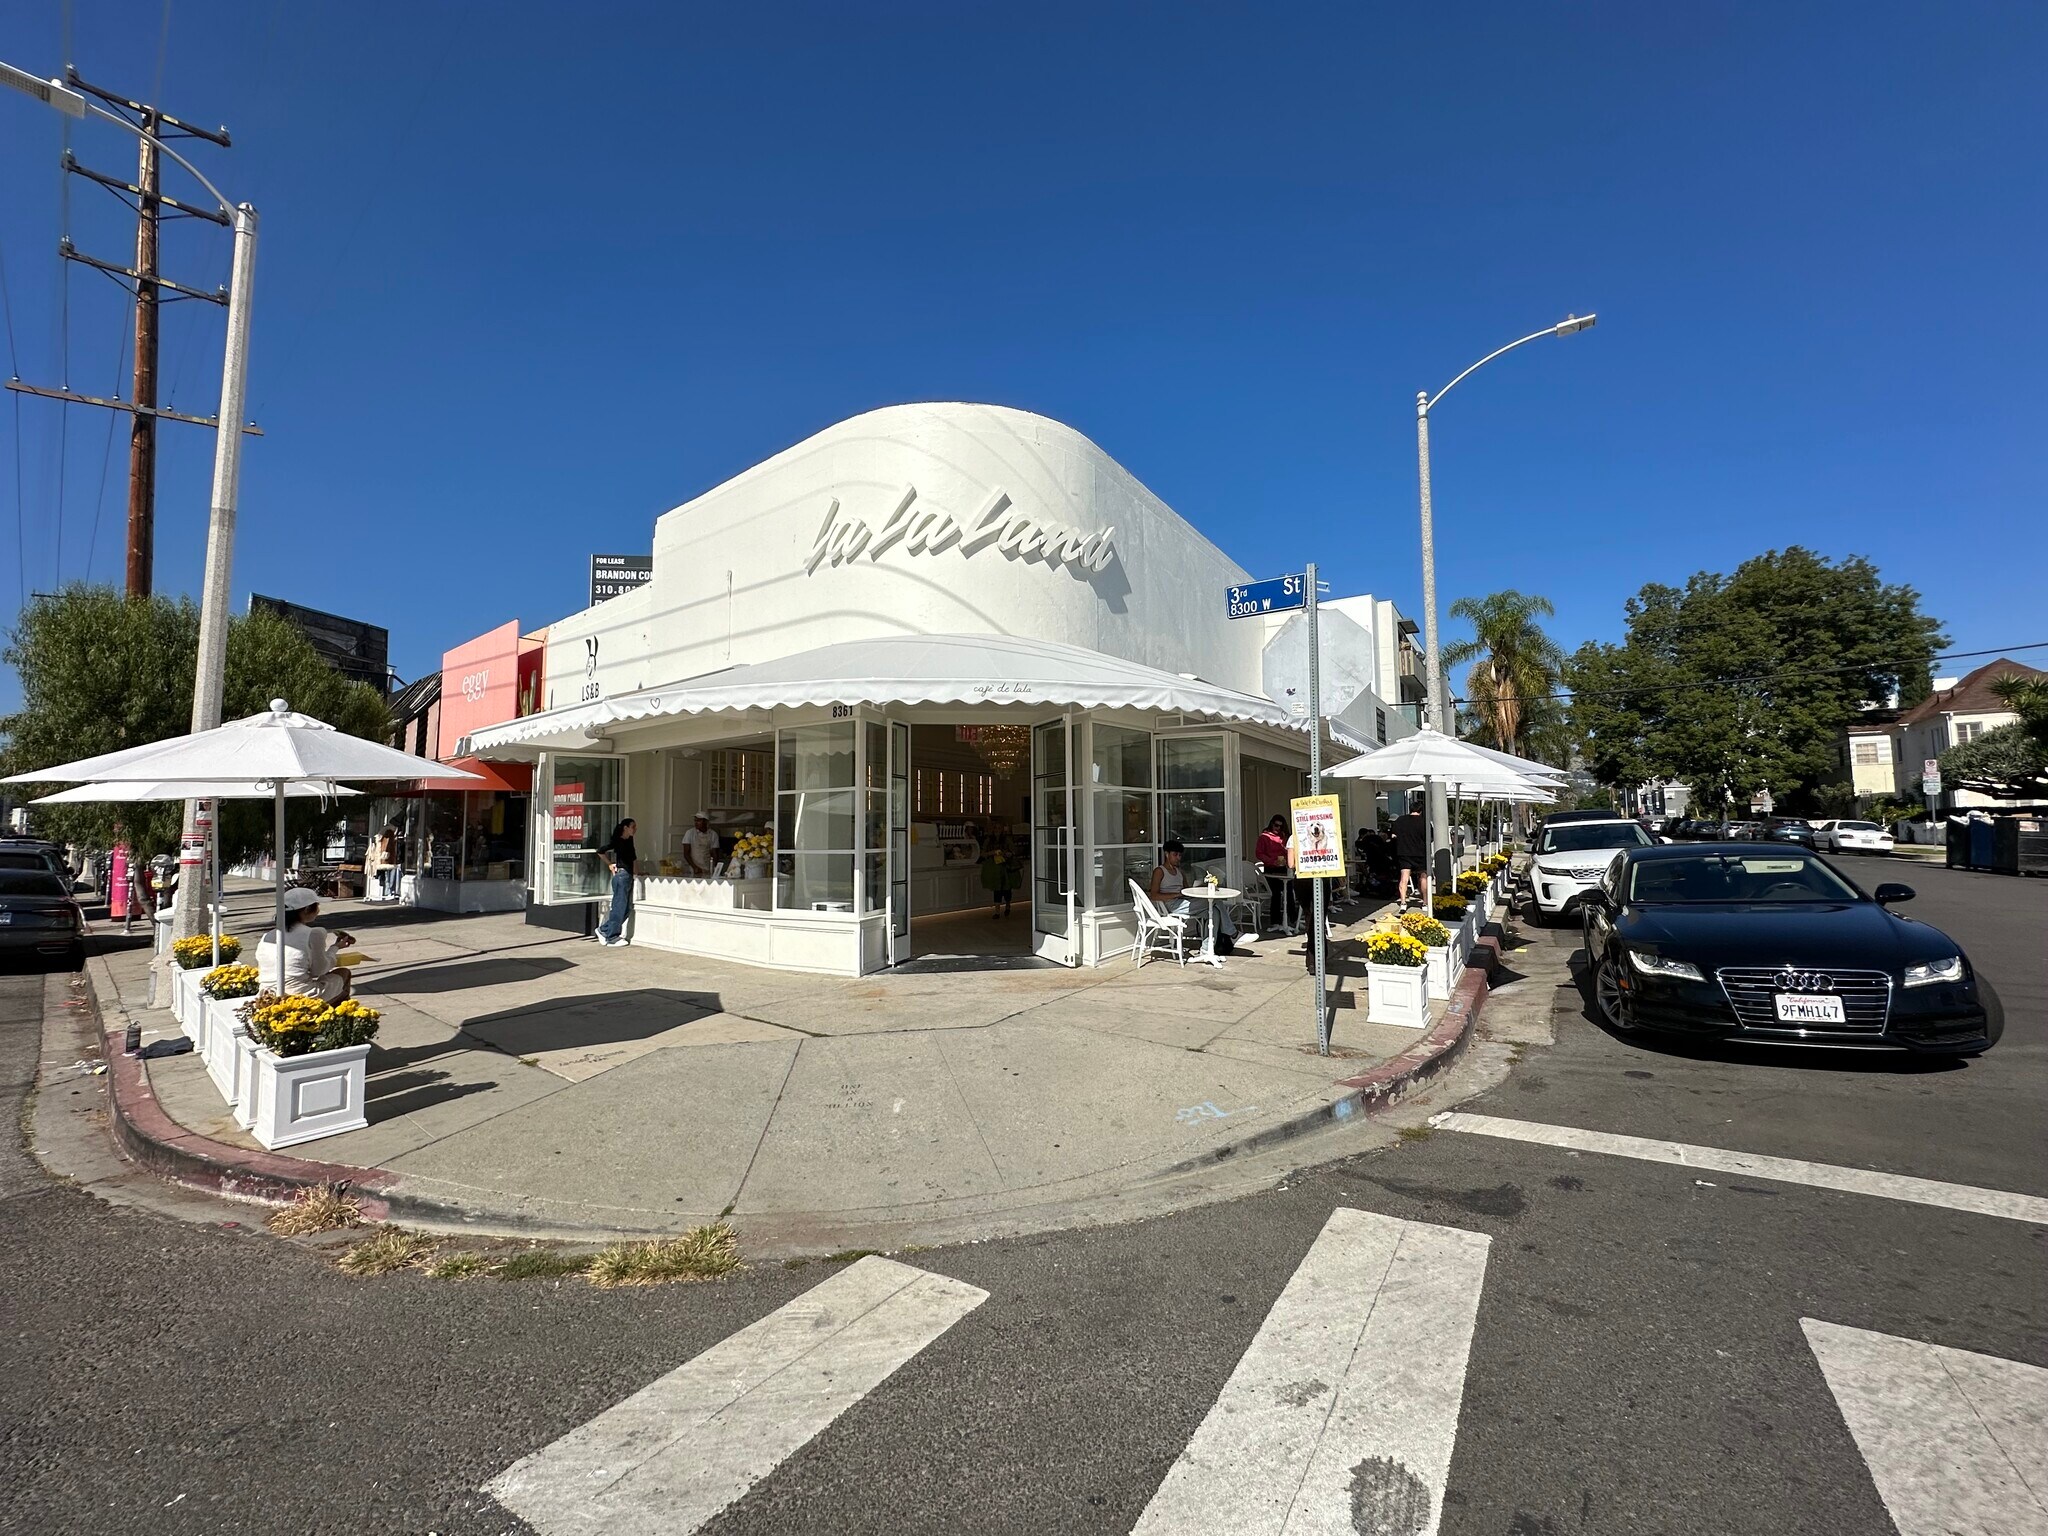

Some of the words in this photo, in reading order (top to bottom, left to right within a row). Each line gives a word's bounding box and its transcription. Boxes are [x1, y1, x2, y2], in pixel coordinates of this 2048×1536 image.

[595, 570, 637, 580] BRANDON
[1230, 587, 1248, 604] 3rd
[1283, 577, 1301, 595] St
[1230, 600, 1258, 616] 8300
[1262, 598, 1271, 611] W
[462, 669, 490, 702] eggy
[581, 682, 600, 702] LS&B
[997, 682, 1010, 693] de
[1013, 682, 1032, 693] lala
[832, 705, 853, 718] 8361
[1309, 813, 1334, 821] MISSING
[1781, 1004, 1838, 1019] 9FMH147
